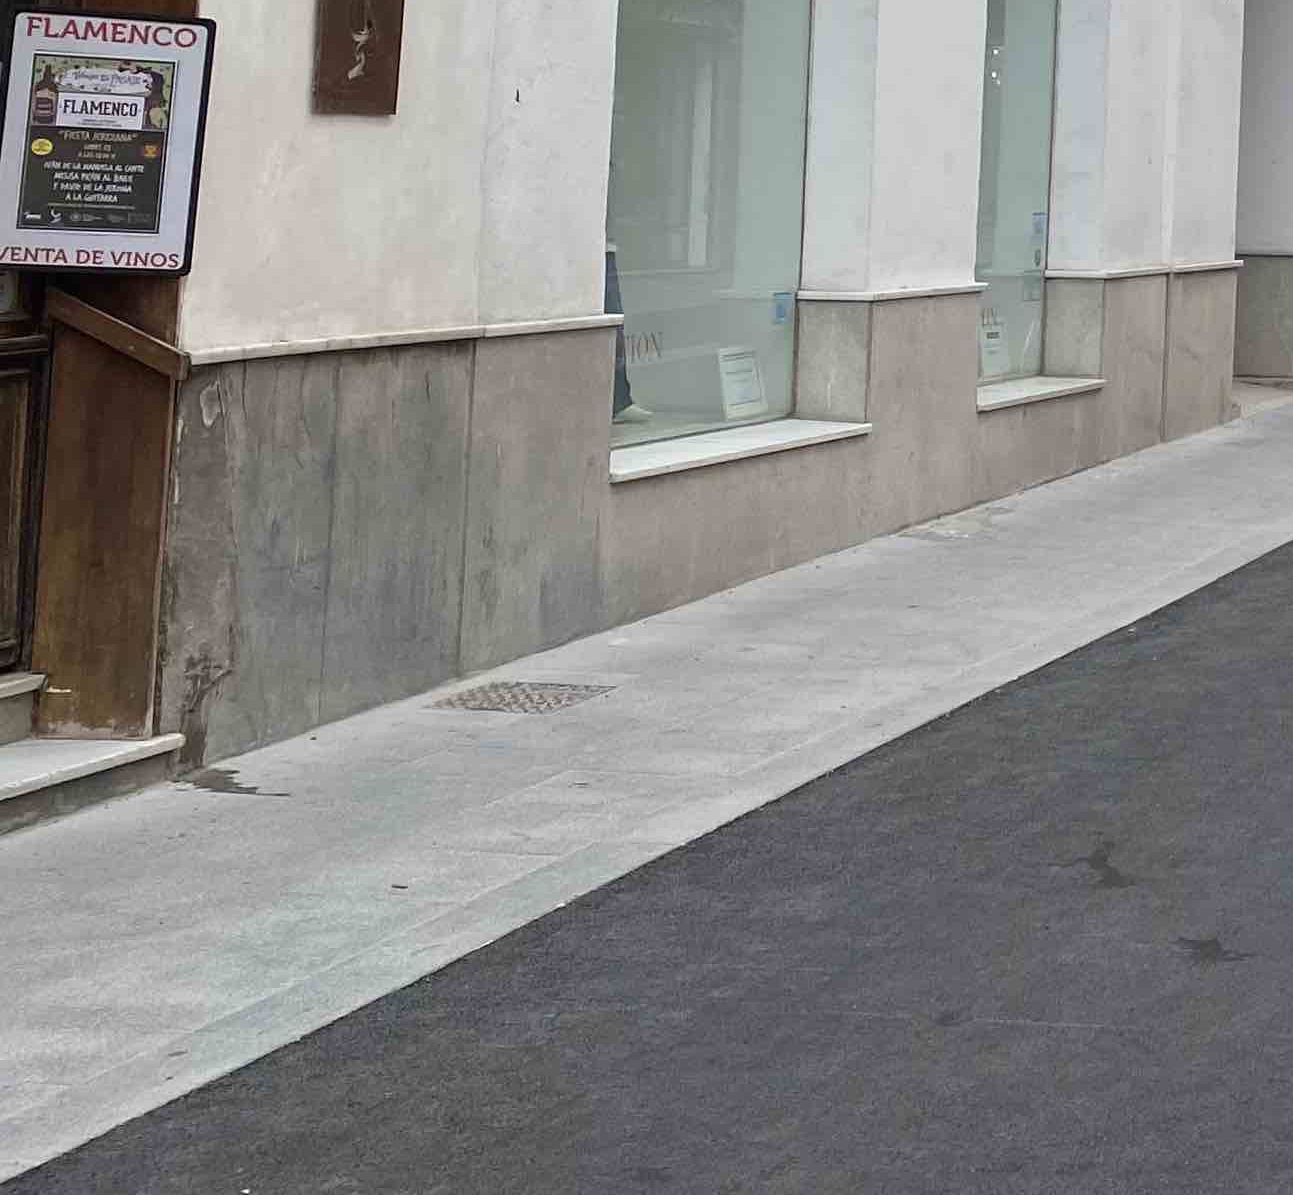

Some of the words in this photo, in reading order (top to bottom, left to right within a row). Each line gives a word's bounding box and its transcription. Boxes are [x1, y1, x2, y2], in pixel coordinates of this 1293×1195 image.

[26, 16, 198, 48] FLAMENCO
[63, 99, 138, 117] FLAMENCO
[76, 249, 104, 265] DE
[111, 250, 179, 268] VINOS
